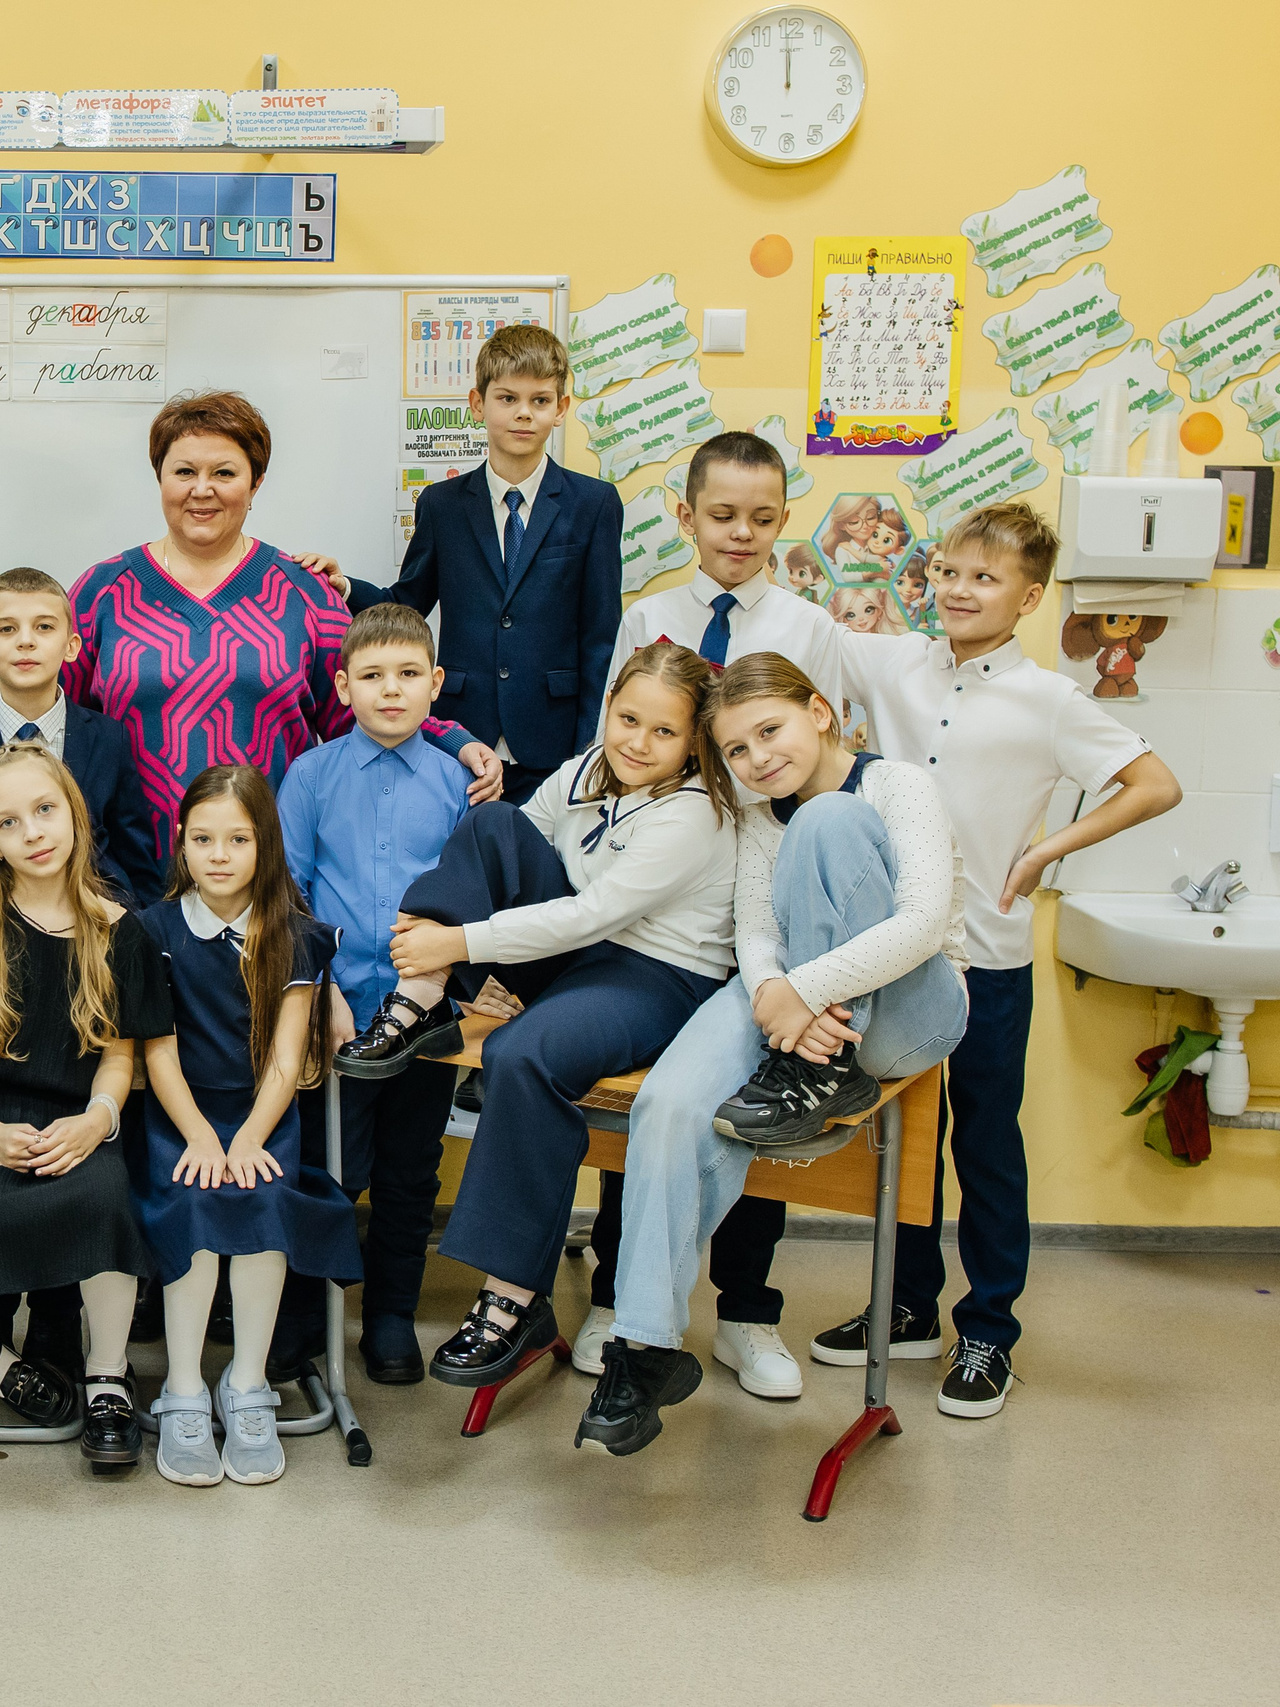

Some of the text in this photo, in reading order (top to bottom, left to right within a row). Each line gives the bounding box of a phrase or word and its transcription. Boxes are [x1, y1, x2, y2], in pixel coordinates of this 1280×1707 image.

[752, 26, 771, 47] 11
[779, 18, 804, 39] 12
[814, 25, 822, 45] 1
[729, 48, 753, 68] 10
[829, 46, 846, 66] 2
[724, 77, 740, 97] 9
[836, 75, 852, 95] 3
[76, 93, 171, 114] метафора
[261, 96, 326, 108] эпитет
[731, 105, 746, 125] 8
[827, 104, 845, 123] 4
[751, 126, 767, 146] 7
[779, 133, 795, 153] 6
[807, 125, 823, 145] 5
[26, 178, 57, 213] Д
[62, 179, 98, 211] Ж
[107, 179, 130, 211] З
[305, 183, 325, 212] Ь
[1028, 207, 1061, 229] книга
[30, 219, 54, 250] Т
[64, 220, 96, 251] Ш
[106, 220, 130, 252] С
[143, 220, 170, 252] Х
[183, 222, 210, 256] Ц
[223, 222, 244, 252] Ч
[256, 222, 291, 257] Щ
[299, 224, 323, 252] Ъ
[828, 252, 952, 264] ПИШИ ПРАВИЛЬНО
[26, 291, 150, 337] декабря
[412, 321, 472, 340] 835 772
[587, 306, 670, 348] умного соседа
[1006, 326, 1043, 349] Книга
[1042, 310, 1071, 330] твой
[1180, 324, 1216, 348] Книга
[1054, 333, 1076, 348] как
[583, 347, 622, 370] книгой
[33, 348, 159, 394] работа
[595, 381, 689, 427] будешь книжки
[639, 407, 684, 430] будешь
[429, 434, 469, 442] ВНУТРЕННЯЯ
[418, 448, 482, 458] ОБОЗНАЧАТЬ БУКВОЙ
[914, 463, 956, 488] Золото
[958, 429, 1014, 468] добывают
[985, 447, 1024, 473] знания
